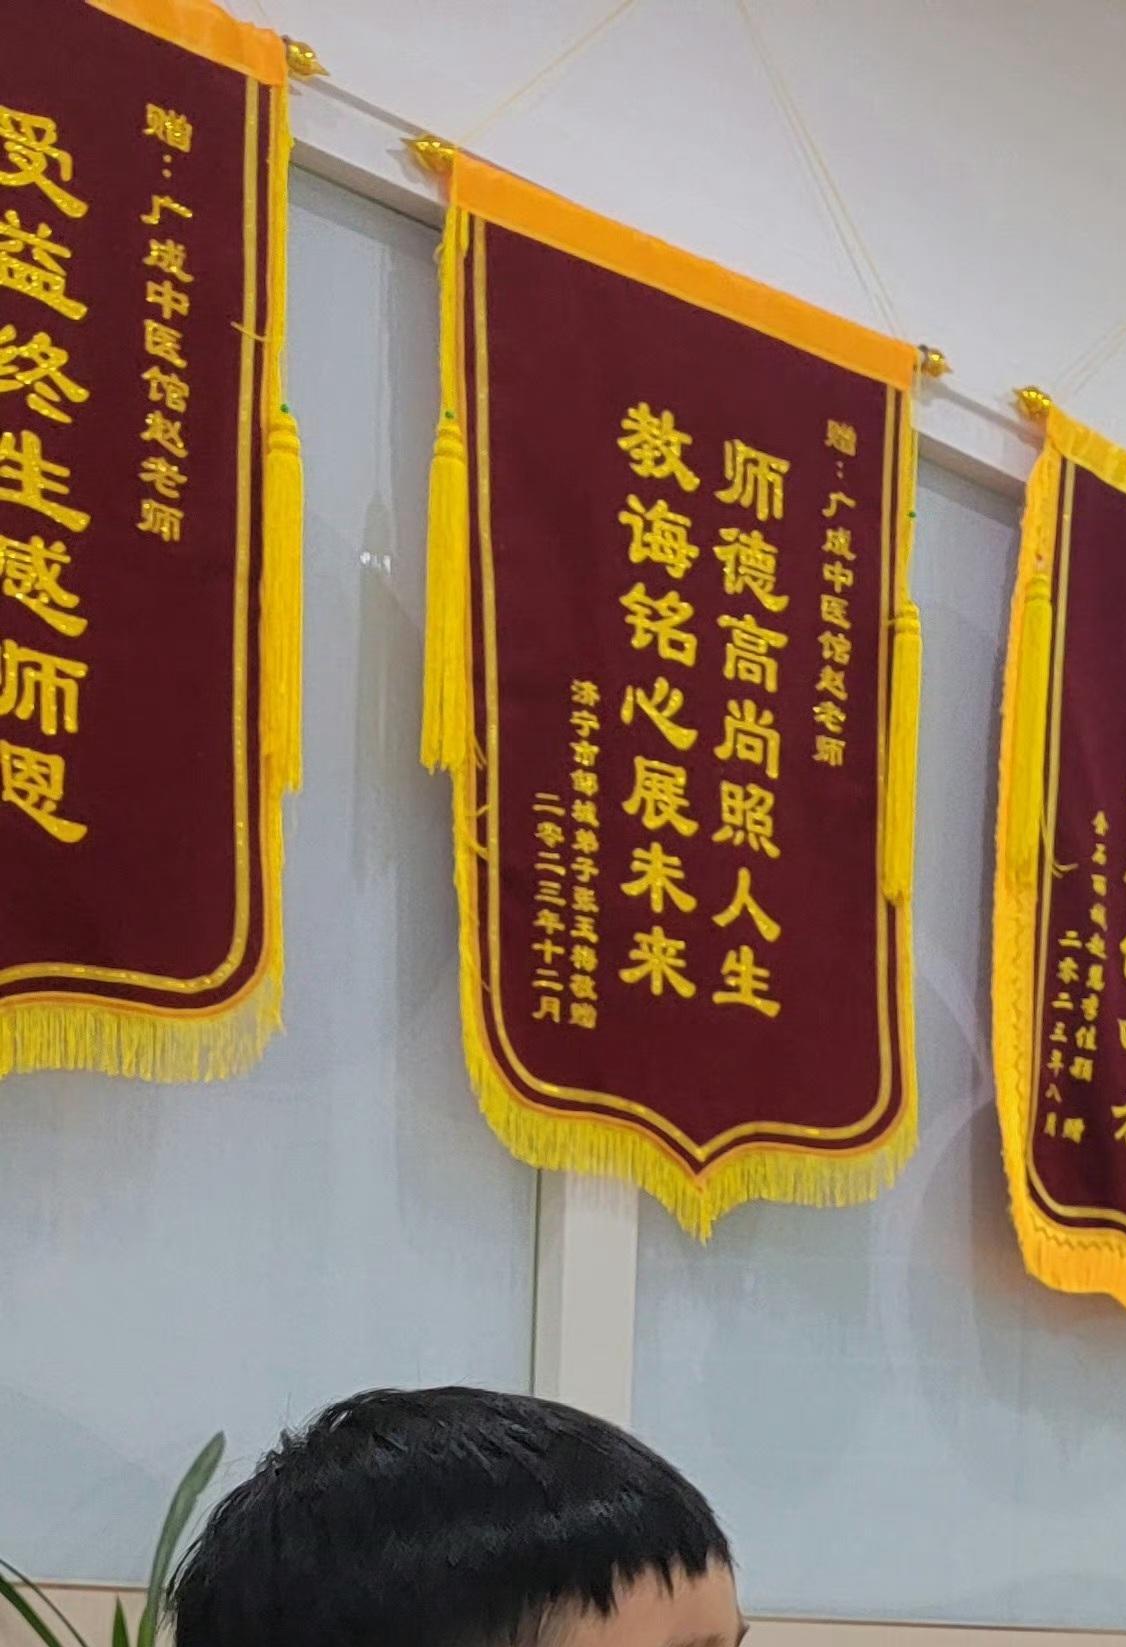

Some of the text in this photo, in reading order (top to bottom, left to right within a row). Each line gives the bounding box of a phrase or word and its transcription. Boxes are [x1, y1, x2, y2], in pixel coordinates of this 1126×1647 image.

[0, 103, 91, 843] 受益终生感师恩
[616, 402, 701, 999] 教诲铭心展未来
[713, 437, 791, 1019] 师德高尚照人生
